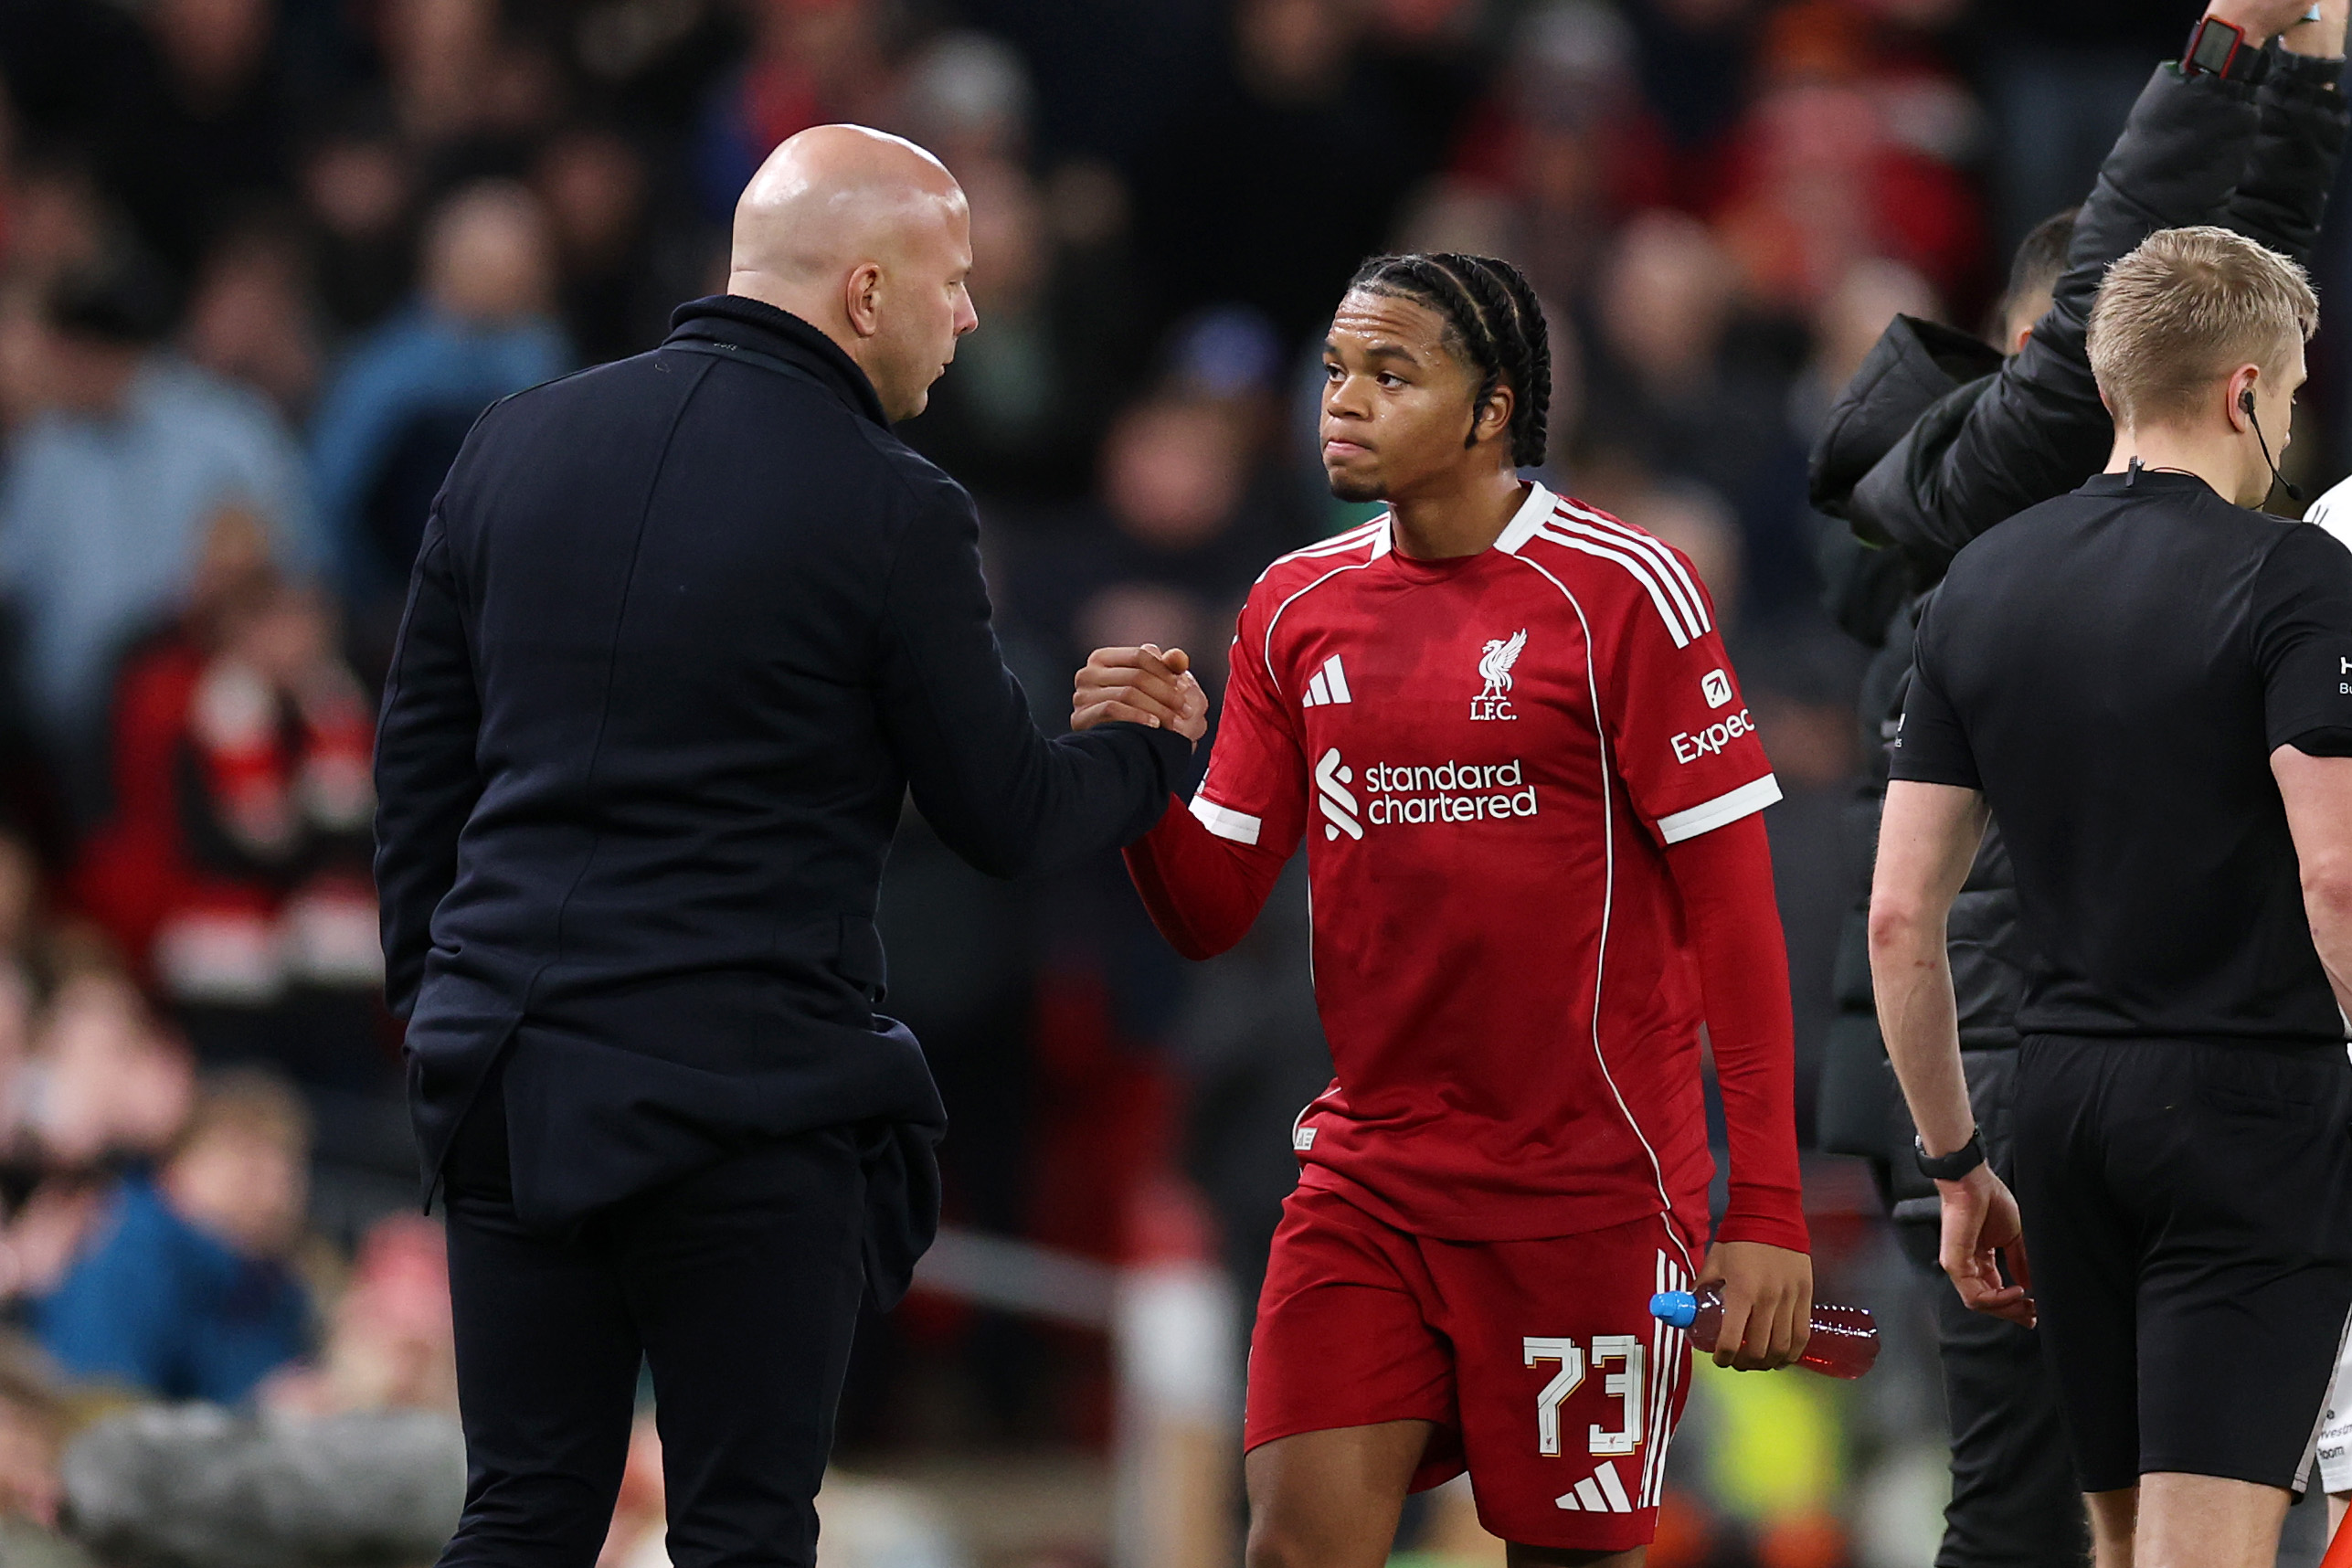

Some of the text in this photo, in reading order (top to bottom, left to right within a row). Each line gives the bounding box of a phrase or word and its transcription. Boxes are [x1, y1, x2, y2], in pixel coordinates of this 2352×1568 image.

[1469, 701, 1518, 720] L.F.C.
[1670, 708, 1755, 764] Expec
[1365, 759, 1522, 792] standard
[1368, 785, 1538, 825] chartered
[1523, 1335, 1647, 1457] 73
